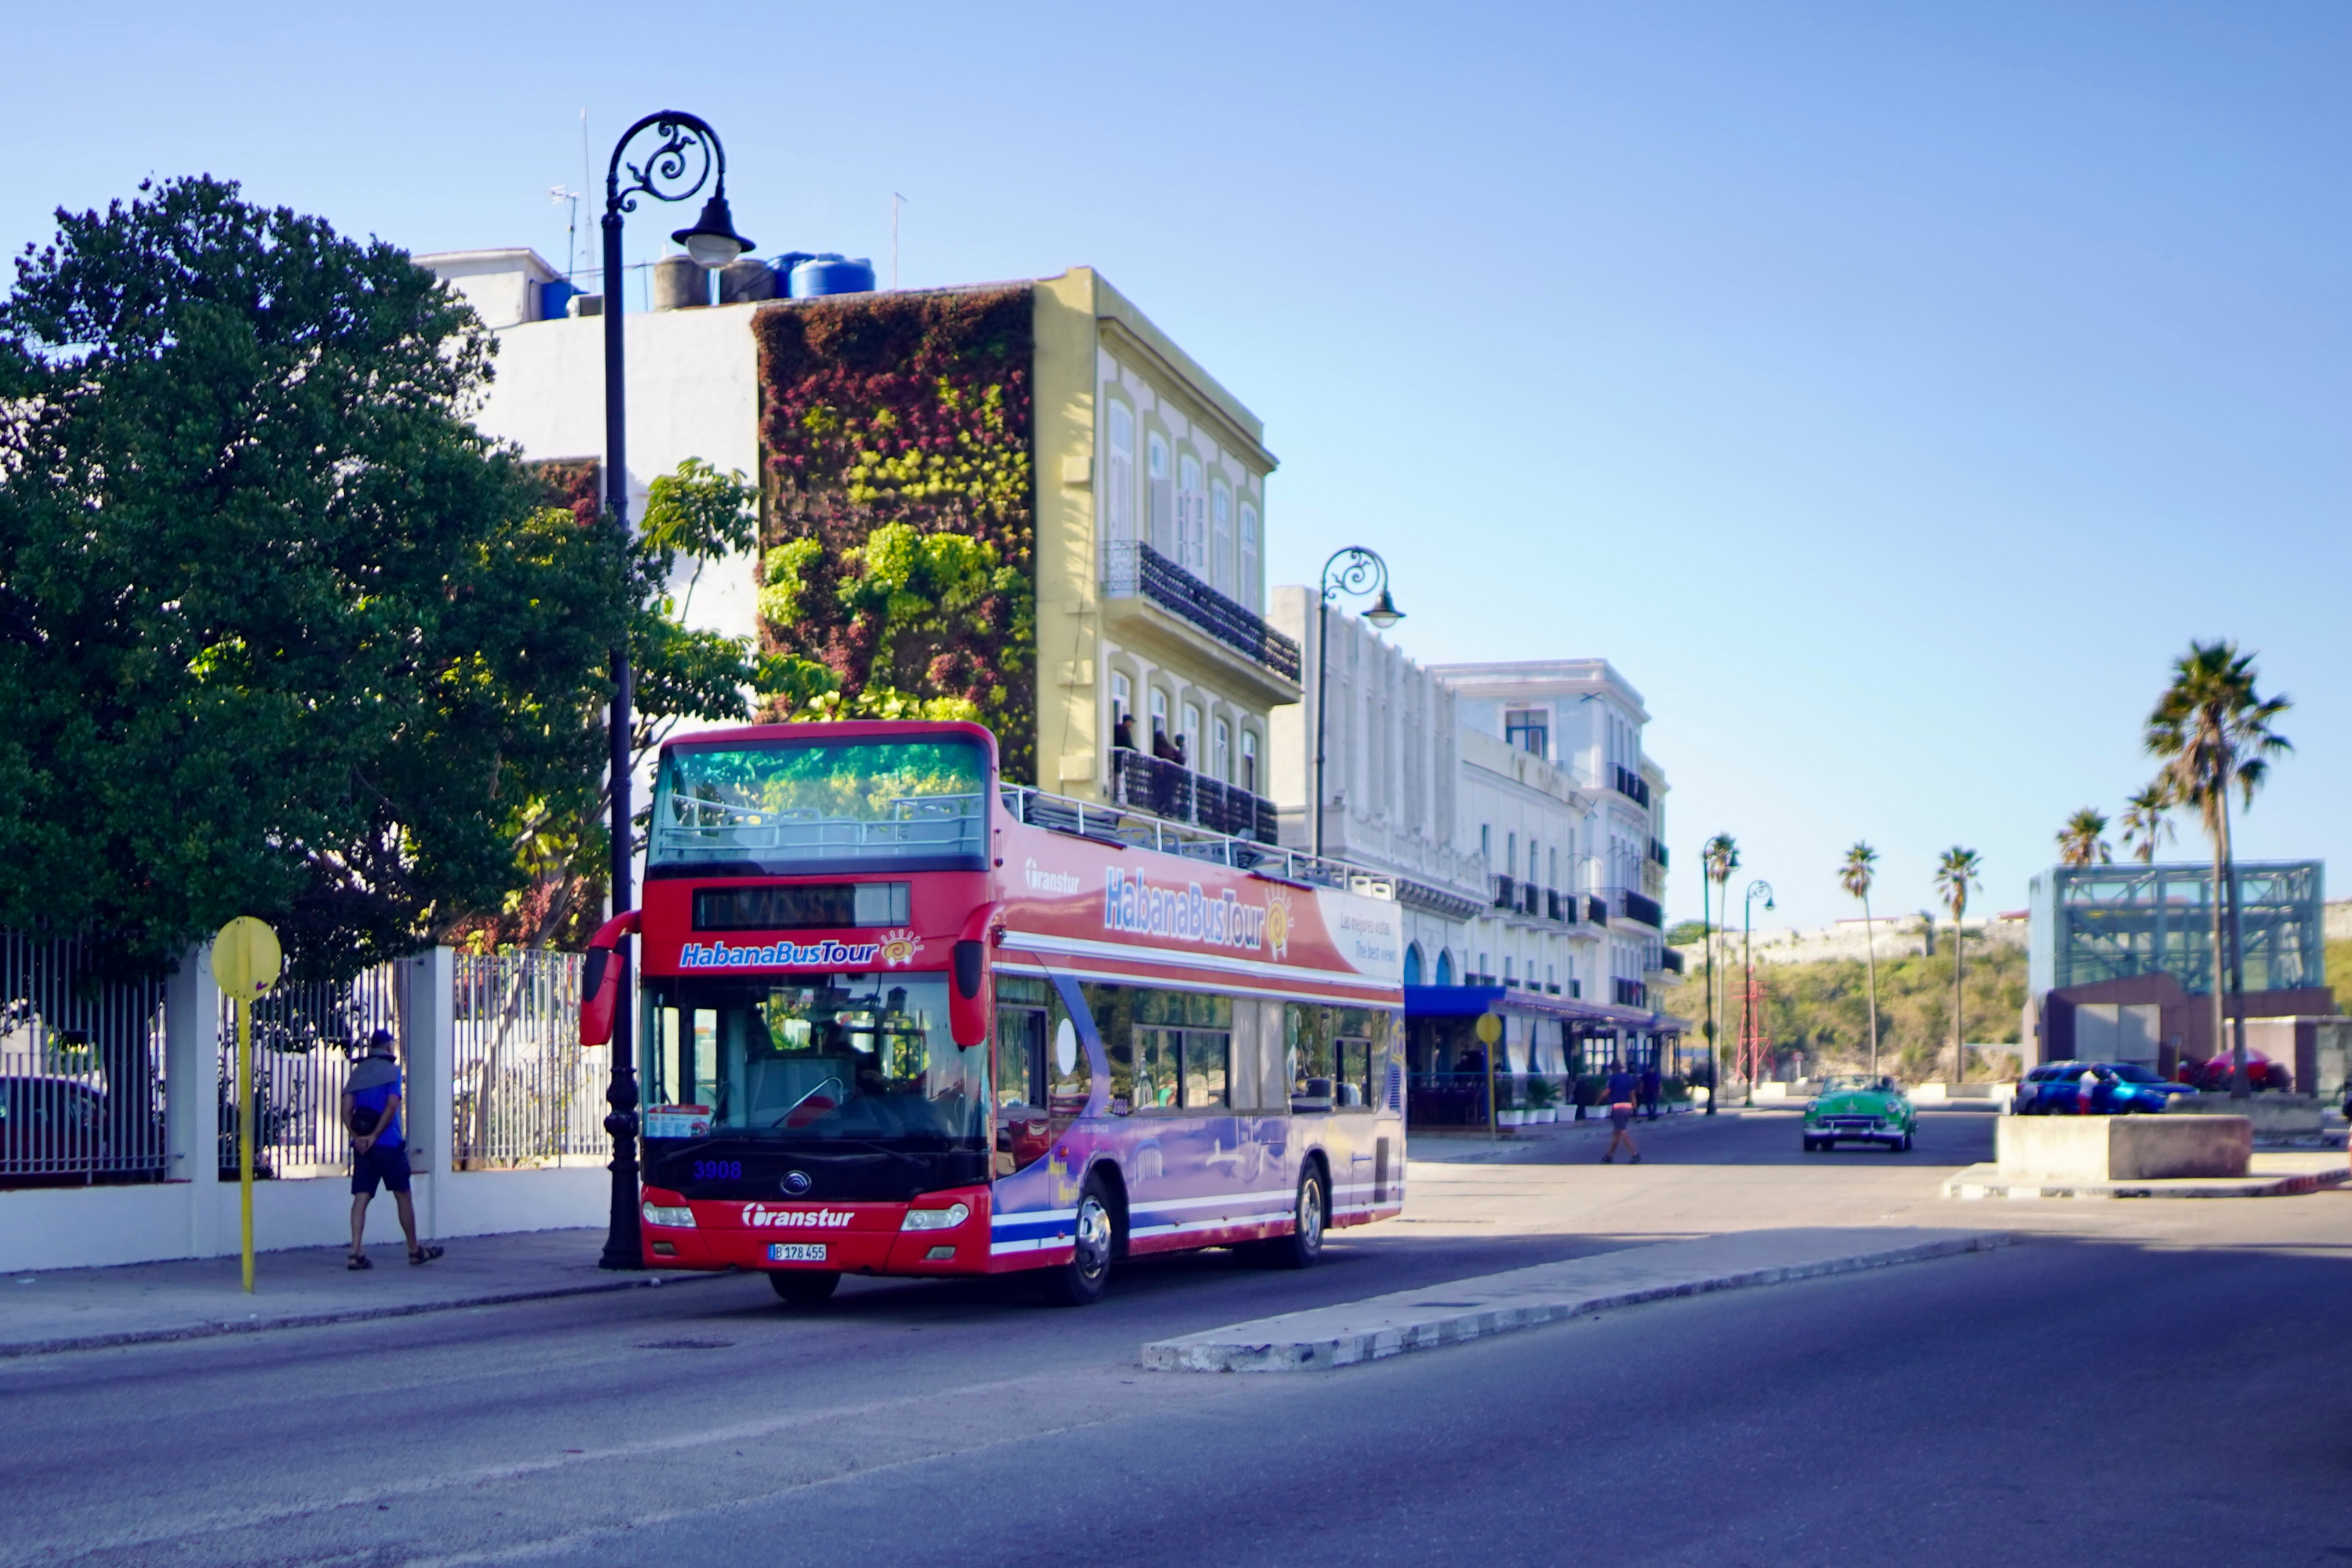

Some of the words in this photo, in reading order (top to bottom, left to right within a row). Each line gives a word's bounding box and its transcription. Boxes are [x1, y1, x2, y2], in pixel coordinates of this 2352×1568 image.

[1025, 857, 1080, 895] Transtur
[1105, 866, 1265, 949] HabanaBusTour
[679, 941, 880, 967] HabanaBusTour
[693, 1160, 742, 1178] 3908
[742, 1202, 855, 1227] Transtur
[775, 1246, 782, 1258] B
[785, 1246, 804, 1258] 178
[806, 1246, 825, 1259] 455
